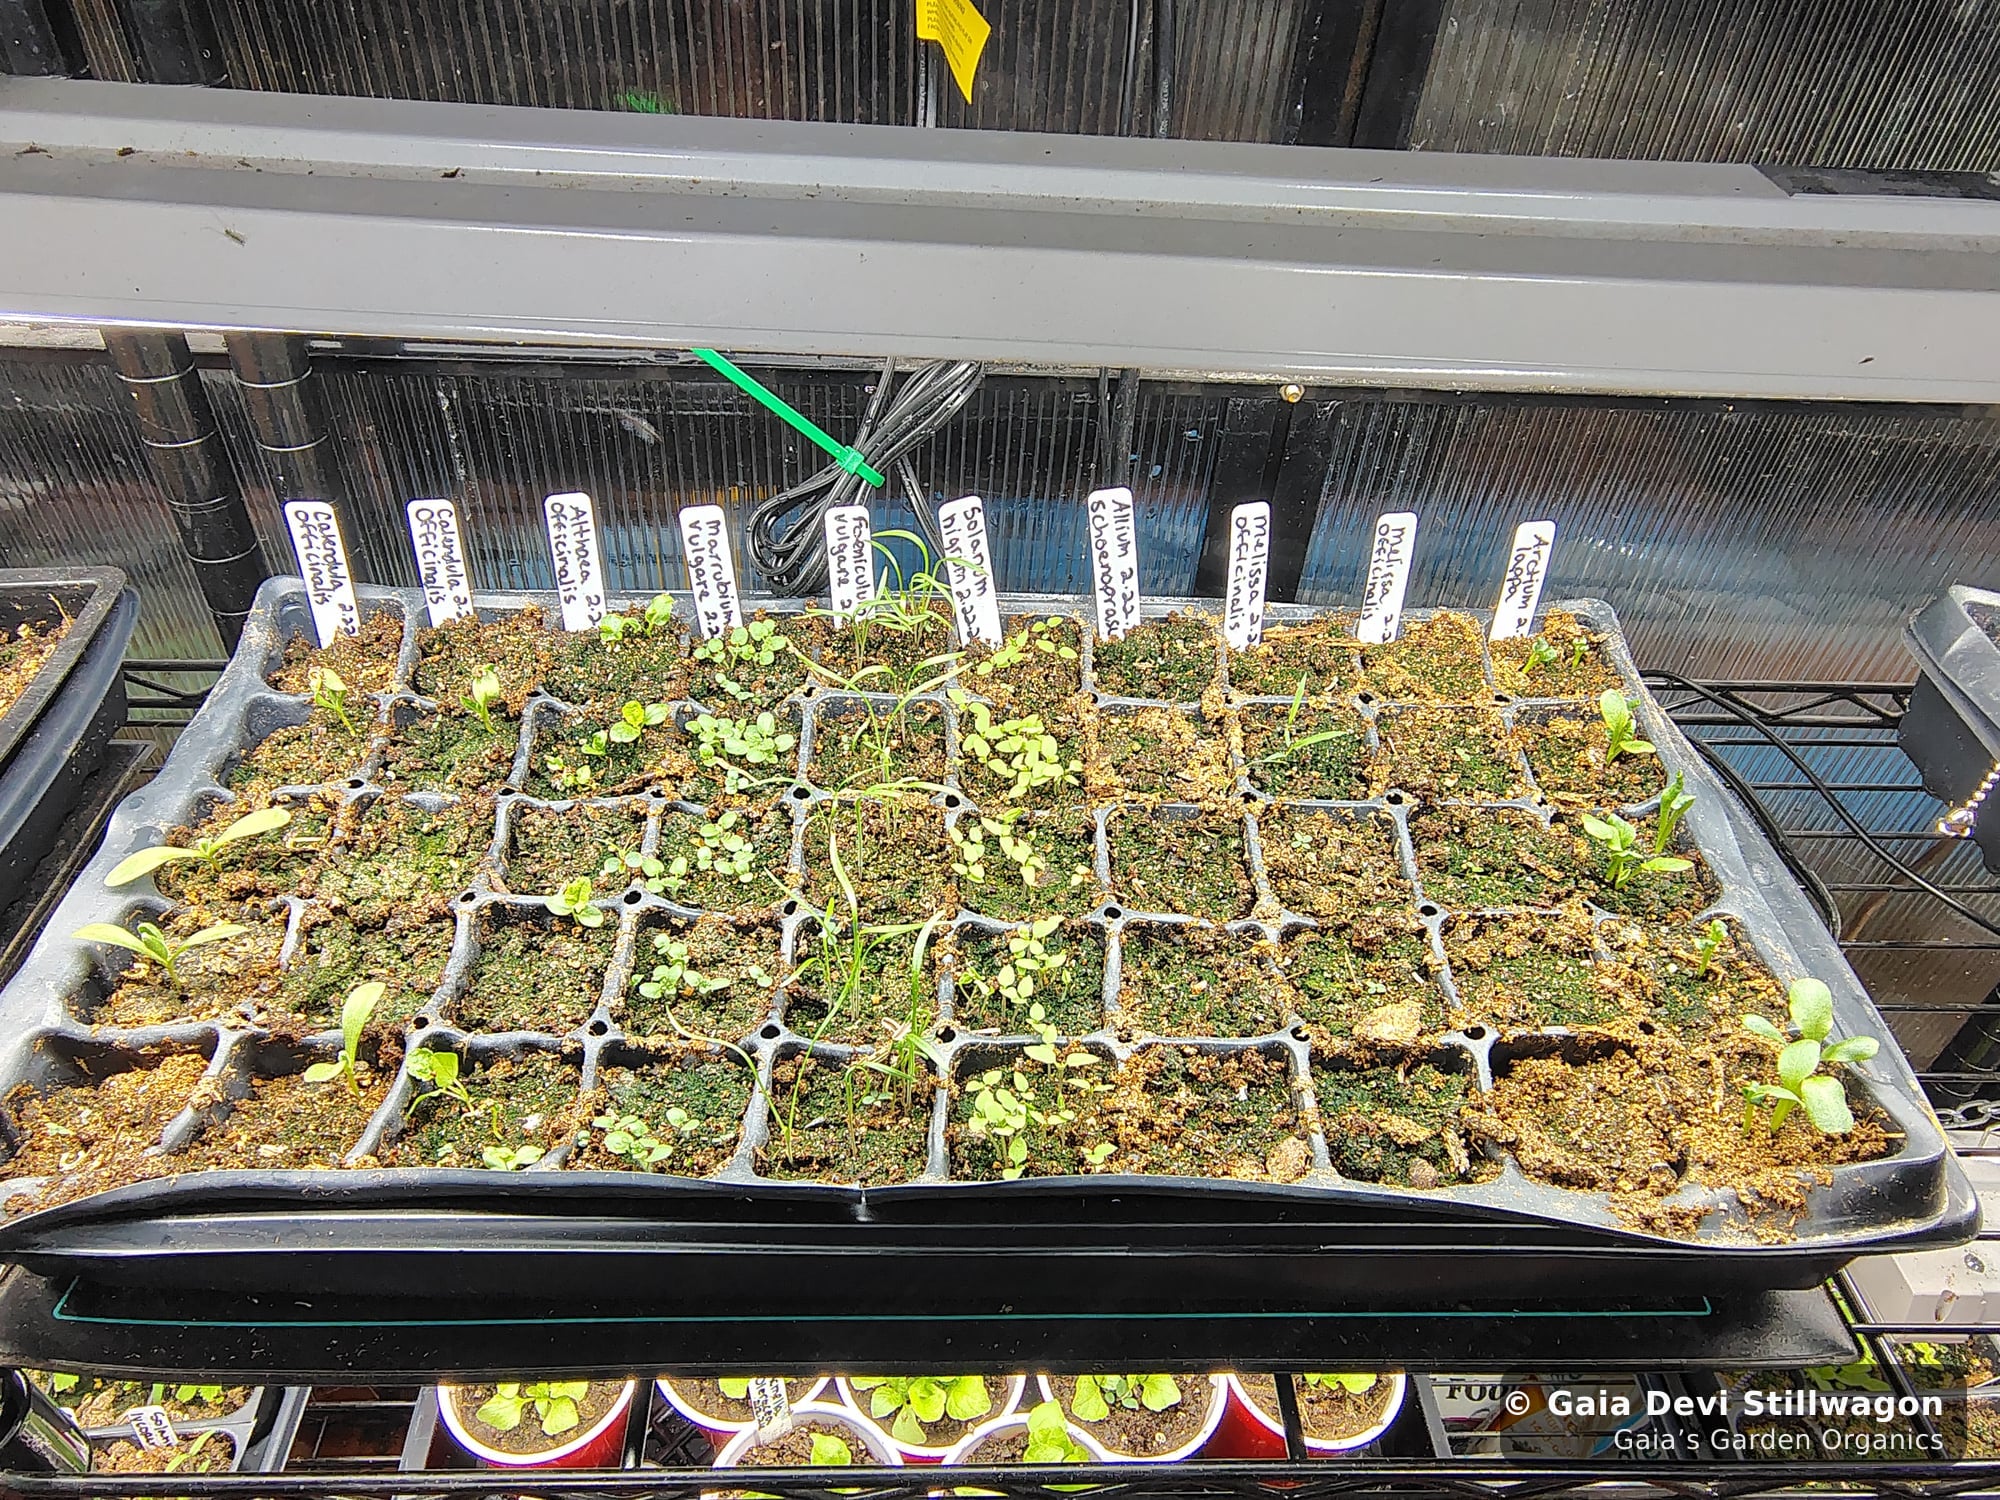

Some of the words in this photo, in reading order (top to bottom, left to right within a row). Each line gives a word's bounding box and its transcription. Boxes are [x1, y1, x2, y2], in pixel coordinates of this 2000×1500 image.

[313, 511, 347, 592] Calendula
[437, 508, 464, 591] Calendula
[569, 504, 591, 585] Althaea
[1111, 499, 1132, 558] Allium
[1504, 546, 1532, 603] lappa
[1517, 533, 1550, 610] Arctium
